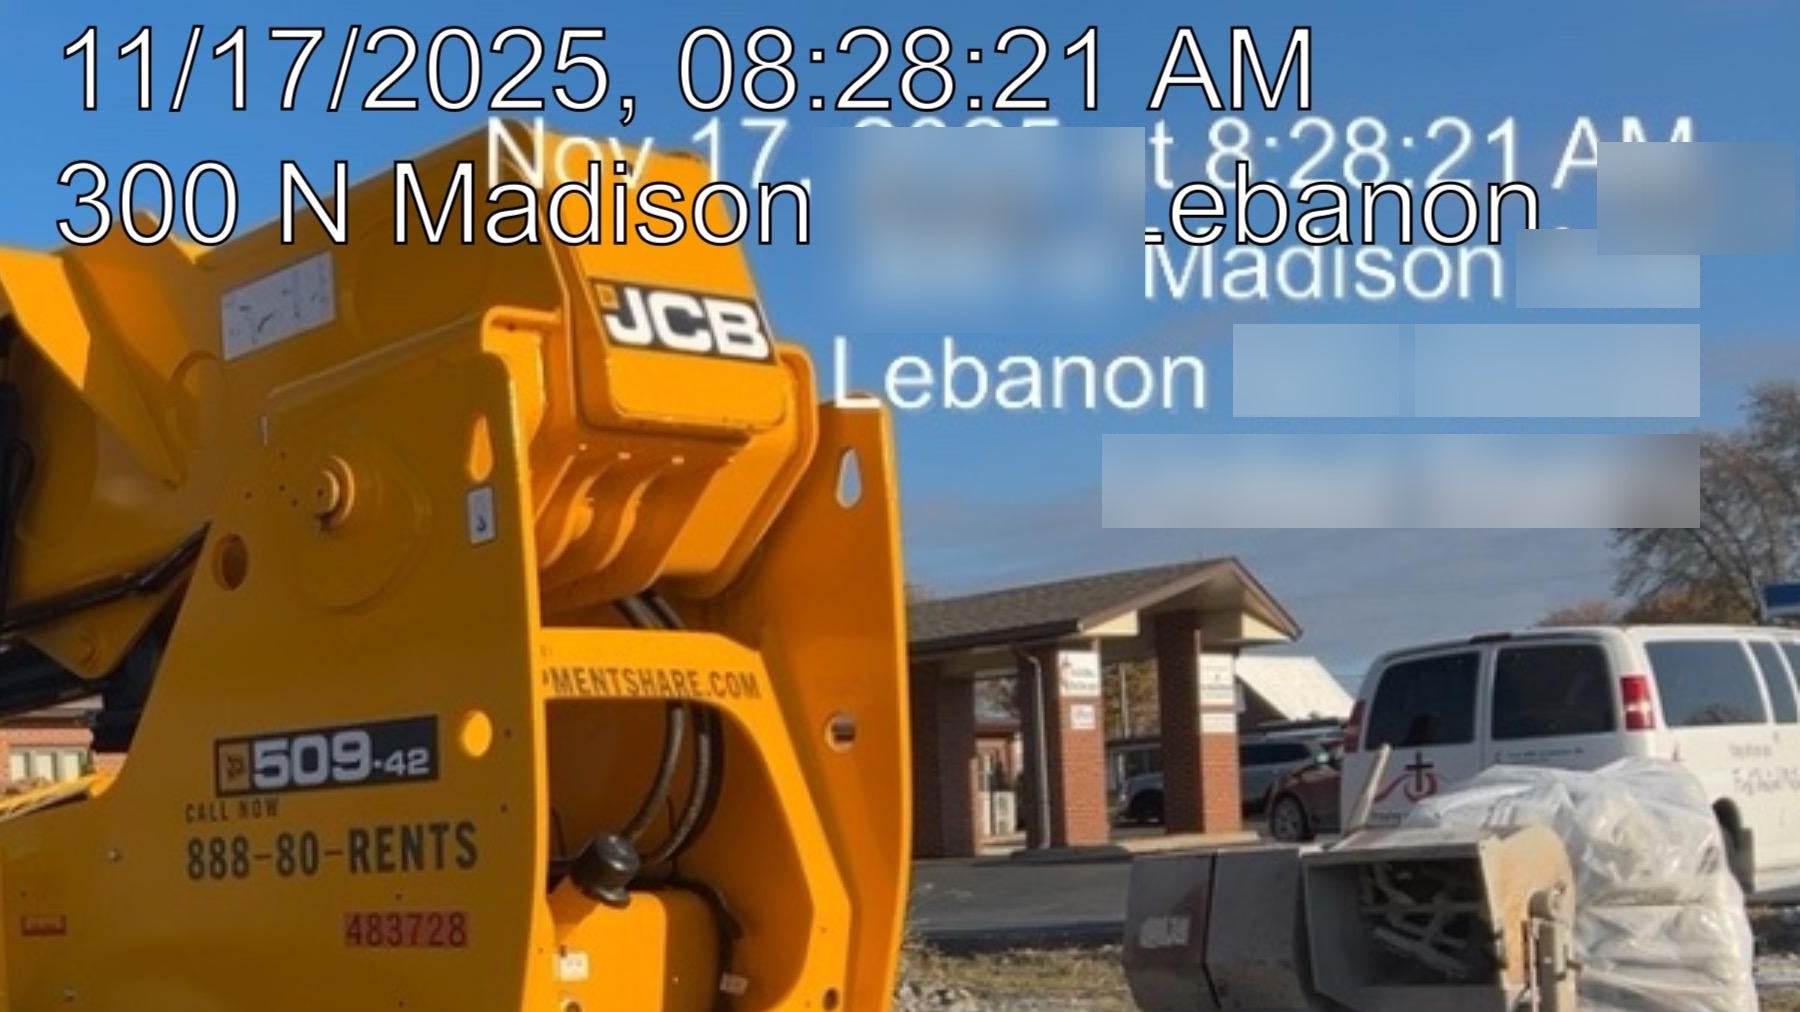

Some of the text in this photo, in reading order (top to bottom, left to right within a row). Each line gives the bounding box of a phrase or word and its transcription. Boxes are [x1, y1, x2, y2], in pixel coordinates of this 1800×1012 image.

[603, 285, 771, 360] JCB
[185, 798, 279, 823] CALL NOW
[187, 820, 479, 881] 888-80-RENTS
[345, 911, 468, 948] 483728
